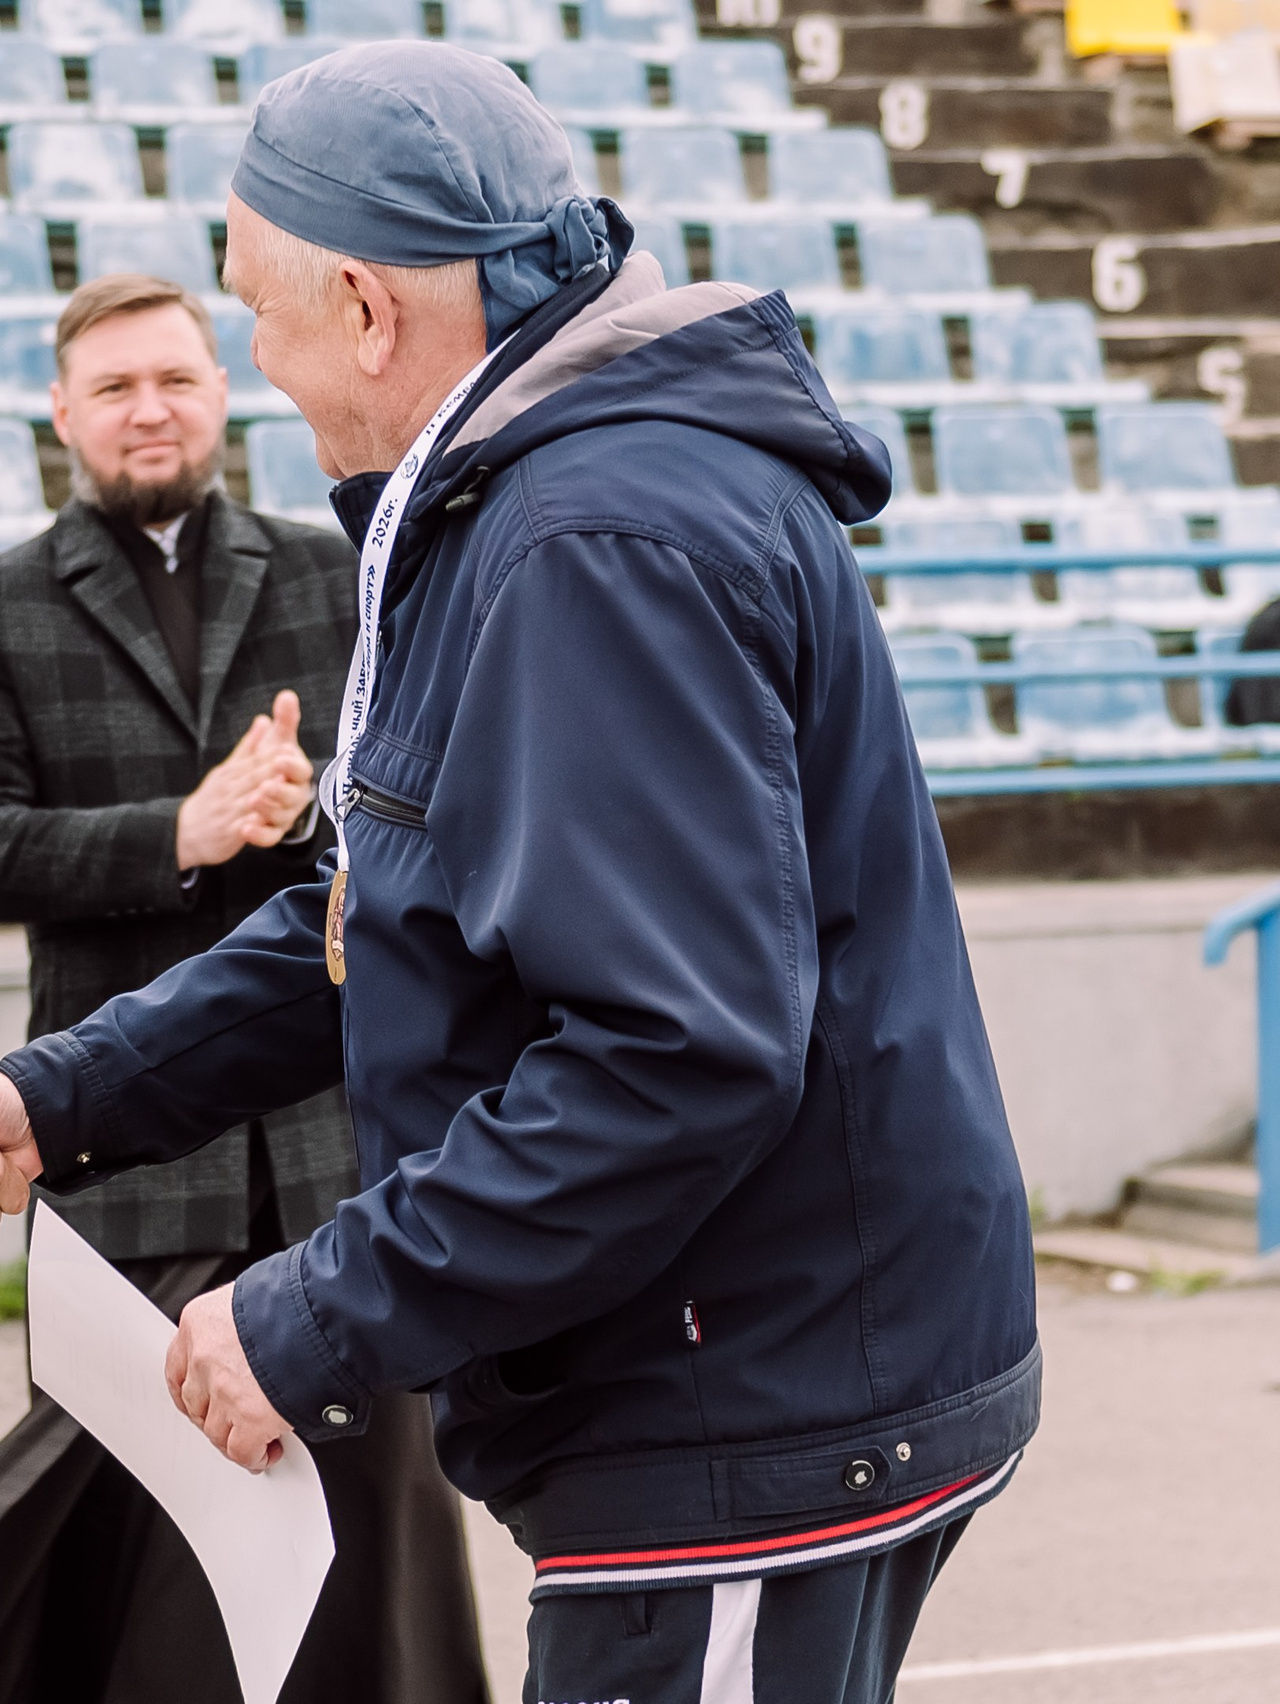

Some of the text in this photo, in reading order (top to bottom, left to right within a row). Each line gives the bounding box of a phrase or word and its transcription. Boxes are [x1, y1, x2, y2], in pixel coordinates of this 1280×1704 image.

[794, 13, 843, 84] 9
[879, 80, 929, 150] 8
[980, 149, 1030, 209] 7
[1092, 237, 1146, 313] 6
[365, 564, 376, 620] спорт»
[372, 498, 398, 549] 2026г.
